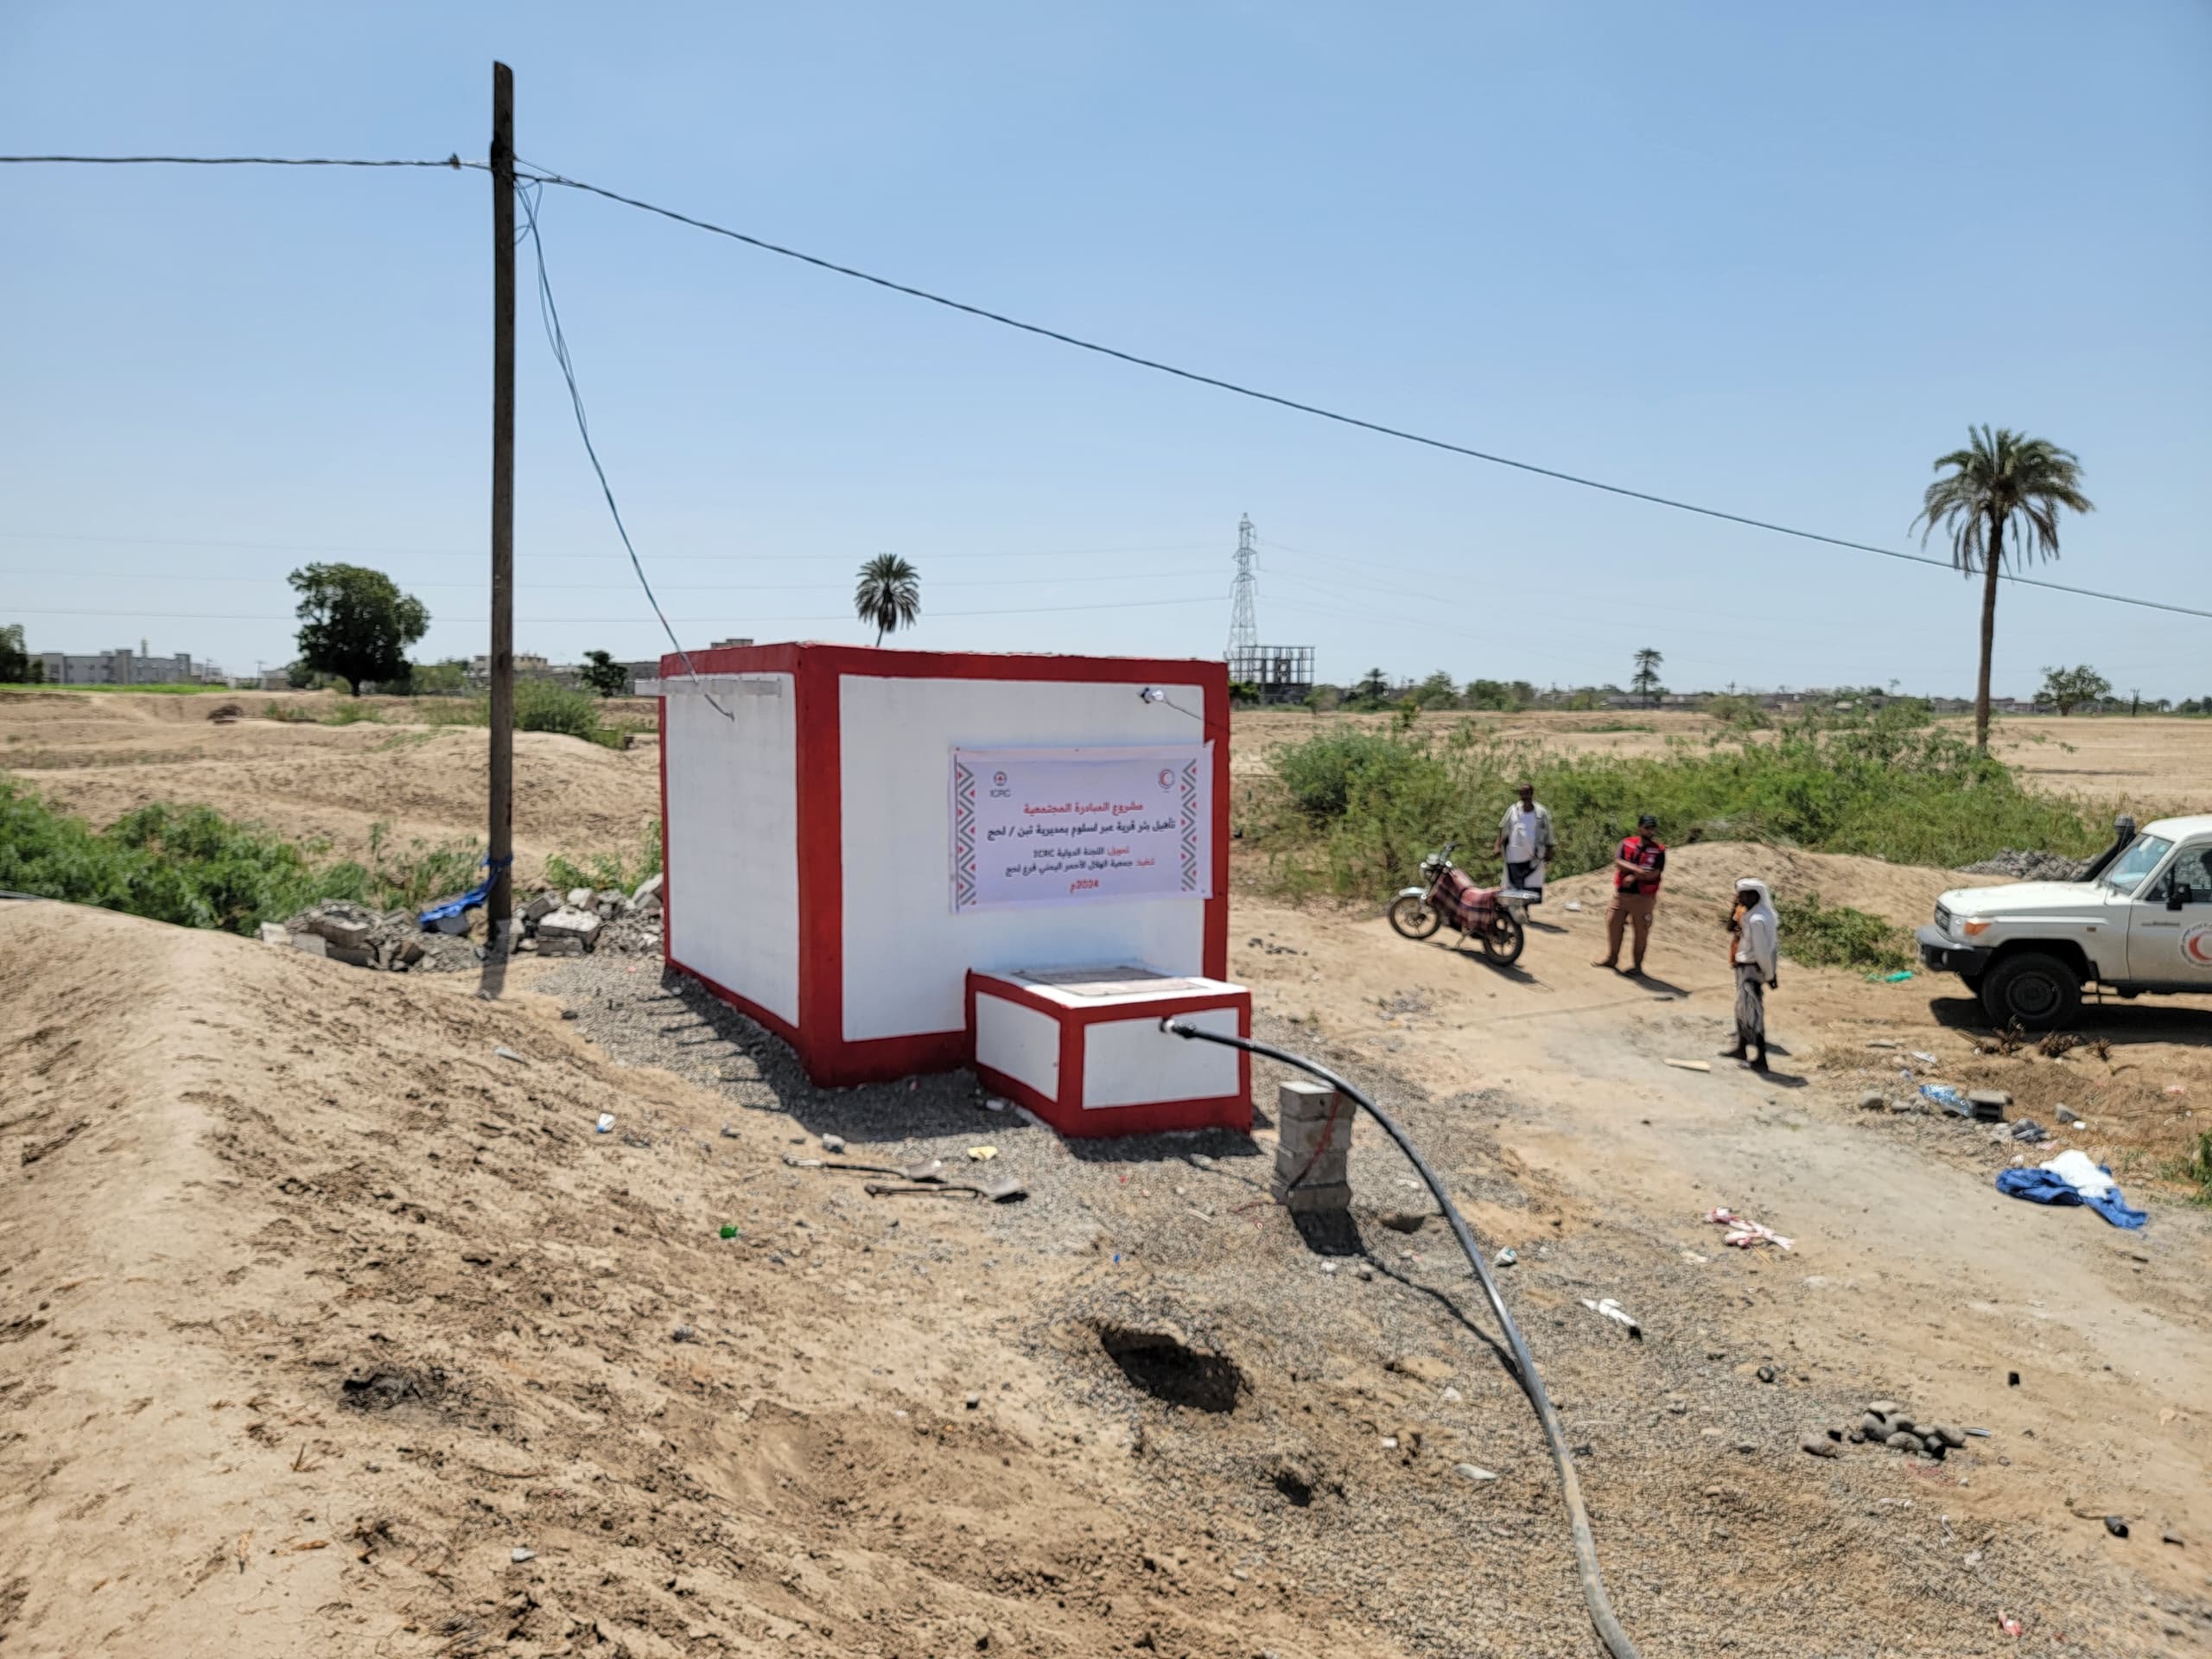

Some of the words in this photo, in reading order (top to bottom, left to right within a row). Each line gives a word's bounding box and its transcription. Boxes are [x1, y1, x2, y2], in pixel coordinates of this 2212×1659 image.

[1023, 804, 1072, 817] المجتمعية
[1075, 802, 1110, 815] المبادرة
[1112, 802, 1143, 816] مشروع
[1036, 823, 1069, 837] بمديرية
[1116, 820, 1135, 834] قرية
[1152, 817, 1176, 832] تأهيل
[987, 826, 1006, 841] لحج
[1057, 848, 1081, 858] الدولية
[1084, 846, 1105, 856] اللجنة
[1005, 864, 1021, 877] لحج
[1088, 860, 1108, 870] الهلال
[1109, 860, 1133, 868] جمعية
